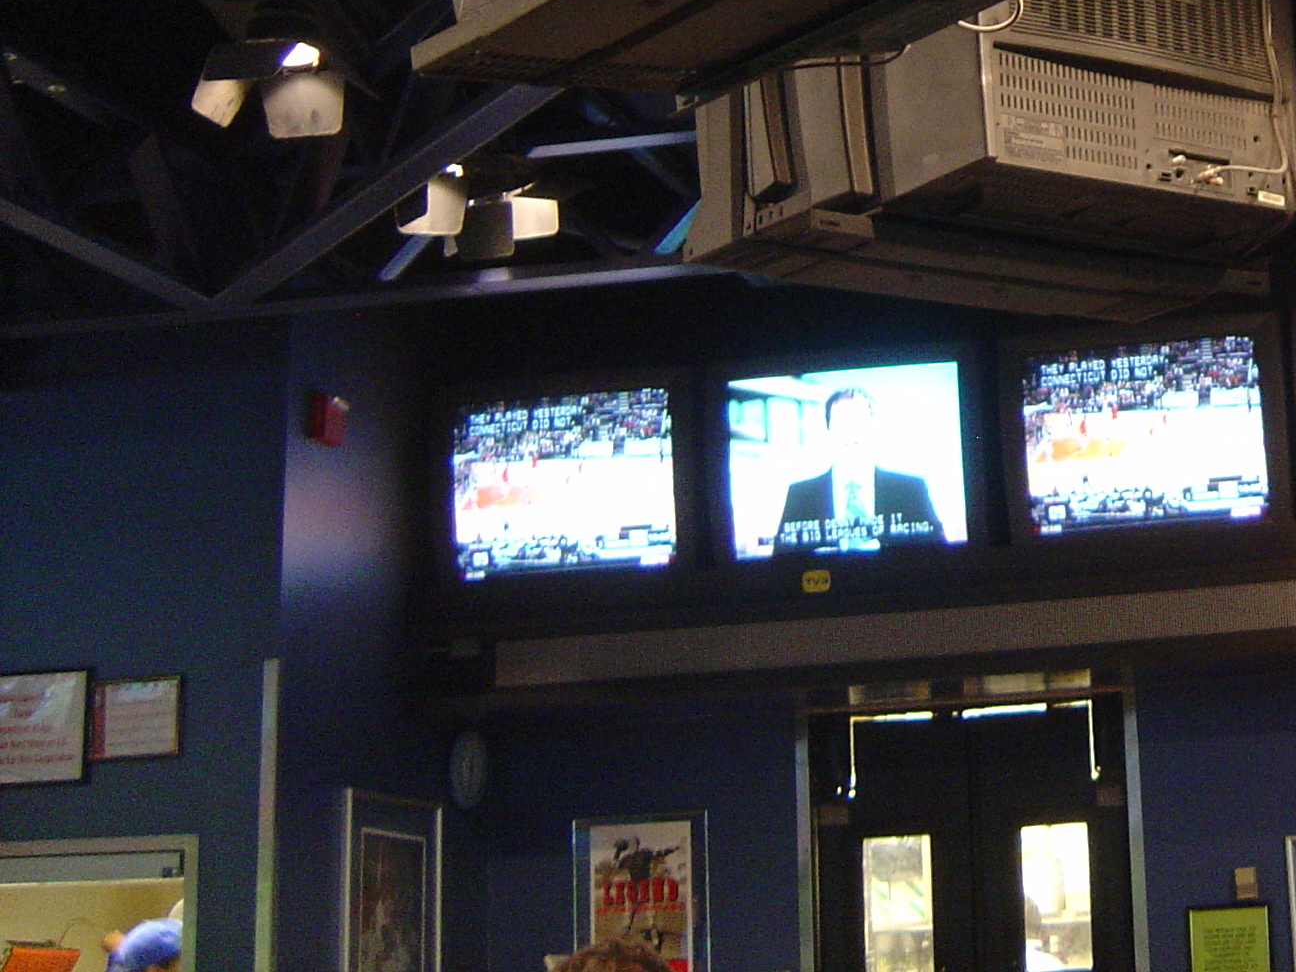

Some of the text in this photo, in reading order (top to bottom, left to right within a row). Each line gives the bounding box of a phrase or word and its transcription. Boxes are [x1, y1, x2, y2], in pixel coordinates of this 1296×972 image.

[1041, 363, 1065, 375] THEY
[1068, 359, 1106, 371] PLAYED
[1041, 370, 1106, 387] CONNECTICUT
[1110, 368, 1130, 380] DID
[470, 414, 491, 425] THEY
[494, 409, 529, 423] PLAYED
[469, 420, 528, 437] CONNECTICUT
[532, 418, 550, 430] DID
[784, 519, 820, 533] BEFORE
[779, 532, 797, 544] THE
